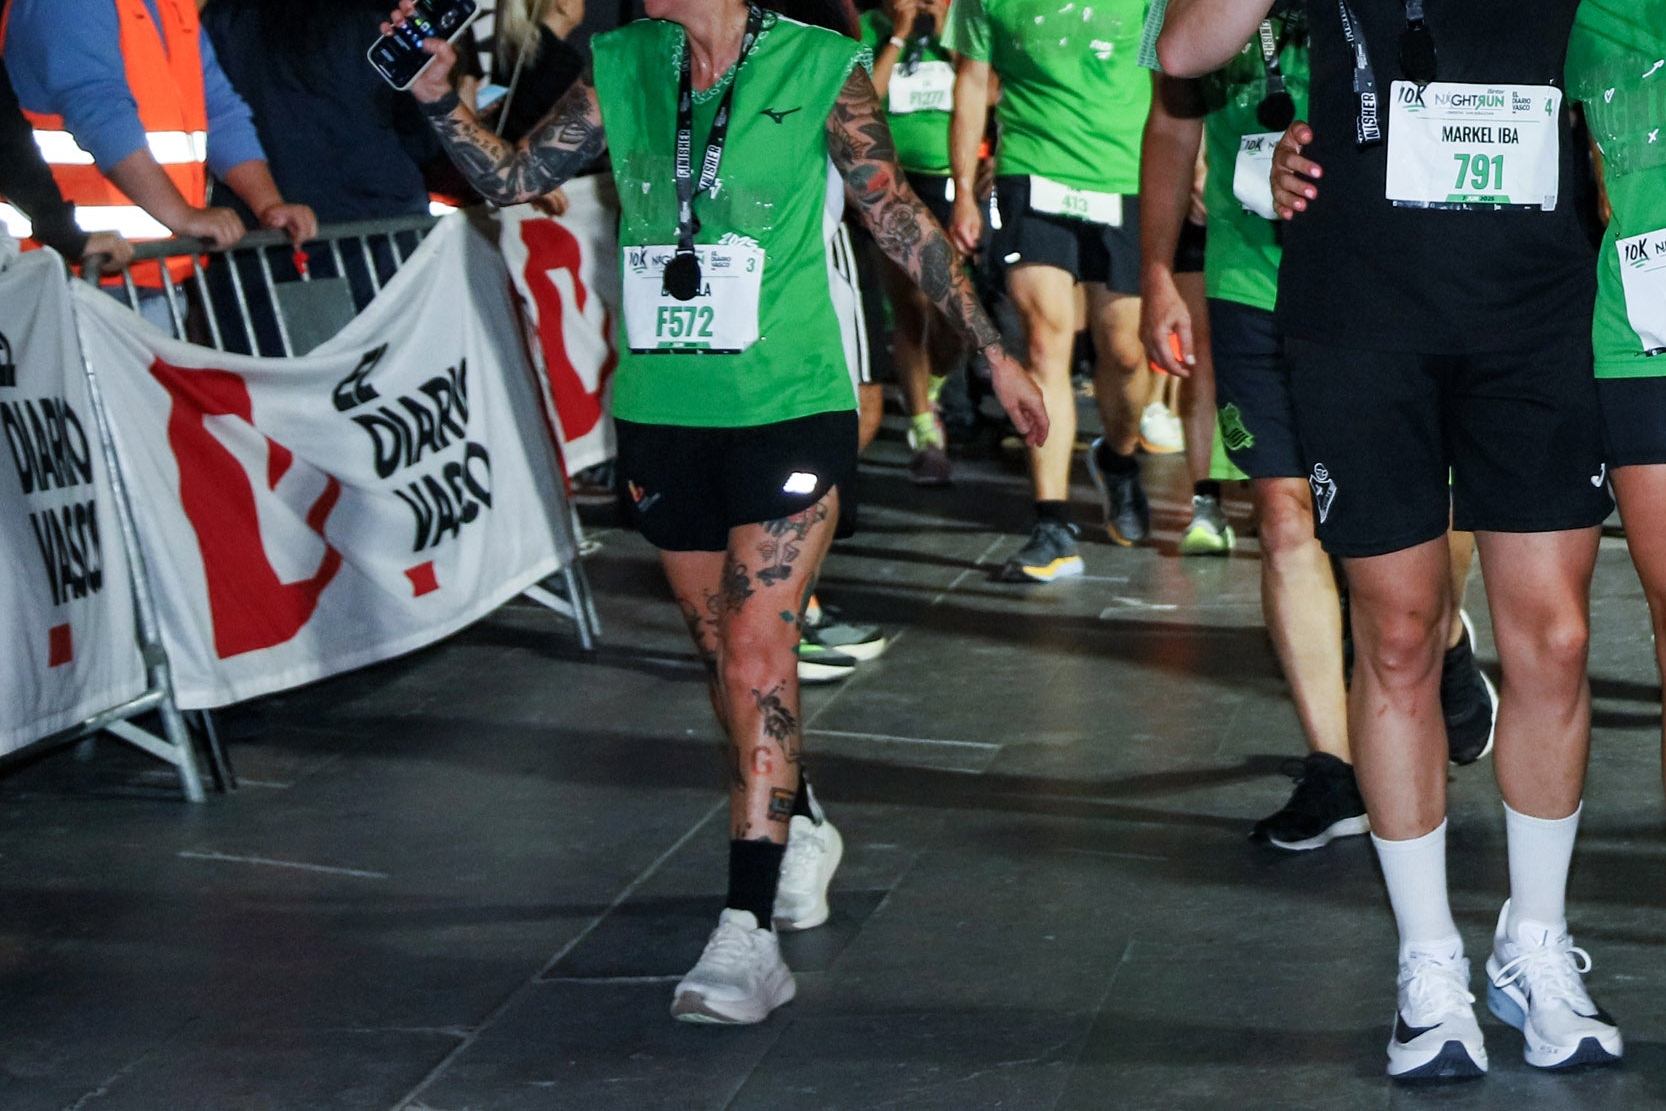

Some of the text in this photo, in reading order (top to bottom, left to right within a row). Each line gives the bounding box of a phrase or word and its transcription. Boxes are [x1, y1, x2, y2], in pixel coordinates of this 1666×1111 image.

[1397, 84, 1426, 107] 10K
[1441, 125, 1519, 145] MARKEL IBA
[1454, 153, 1505, 190] 791
[1061, 195, 1088, 213] 413
[629, 250, 648, 267] 10K
[1624, 237, 1650, 263] 10K
[746, 257, 756, 273] 3
[656, 305, 715, 338] F572
